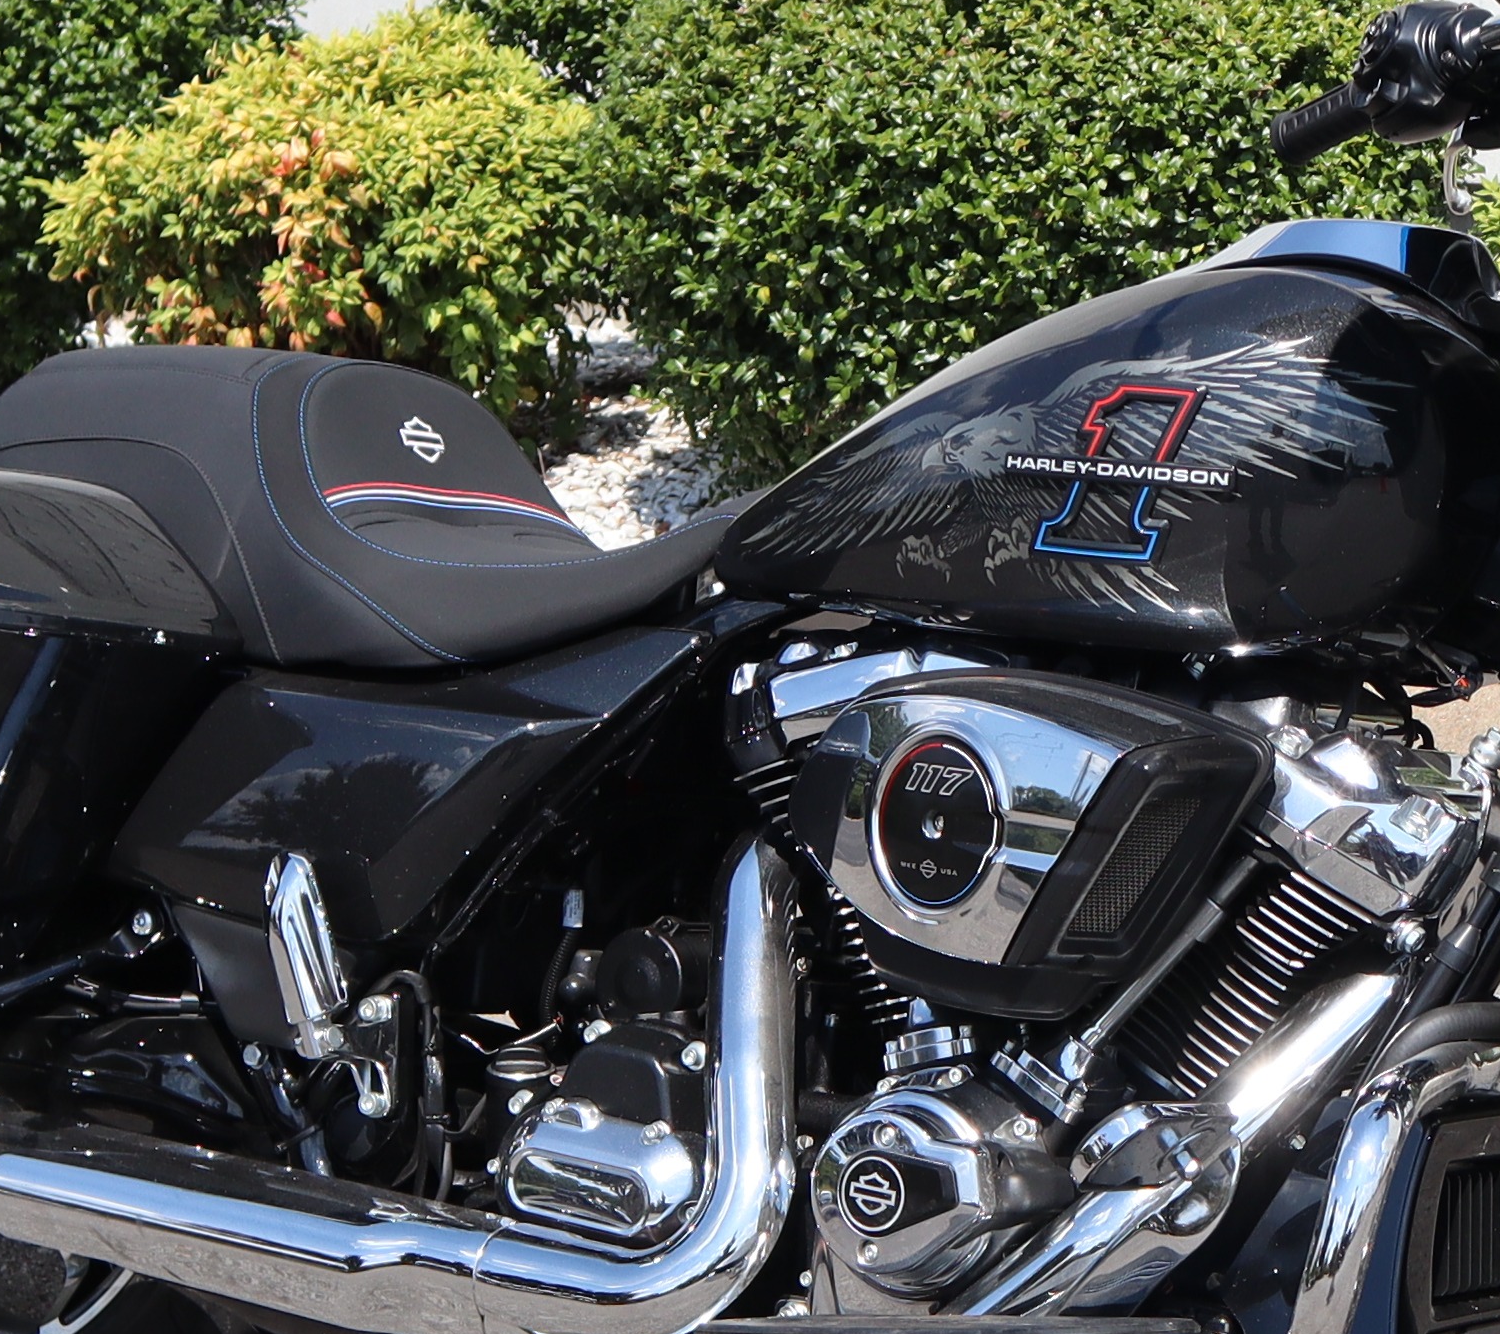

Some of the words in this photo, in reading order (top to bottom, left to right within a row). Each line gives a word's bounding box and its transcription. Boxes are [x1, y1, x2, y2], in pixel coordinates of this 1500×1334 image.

[1007, 456, 1230, 486] HARLEY-DAVIDSON
[905, 762, 975, 796] 117
[940, 867, 959, 877] USA
